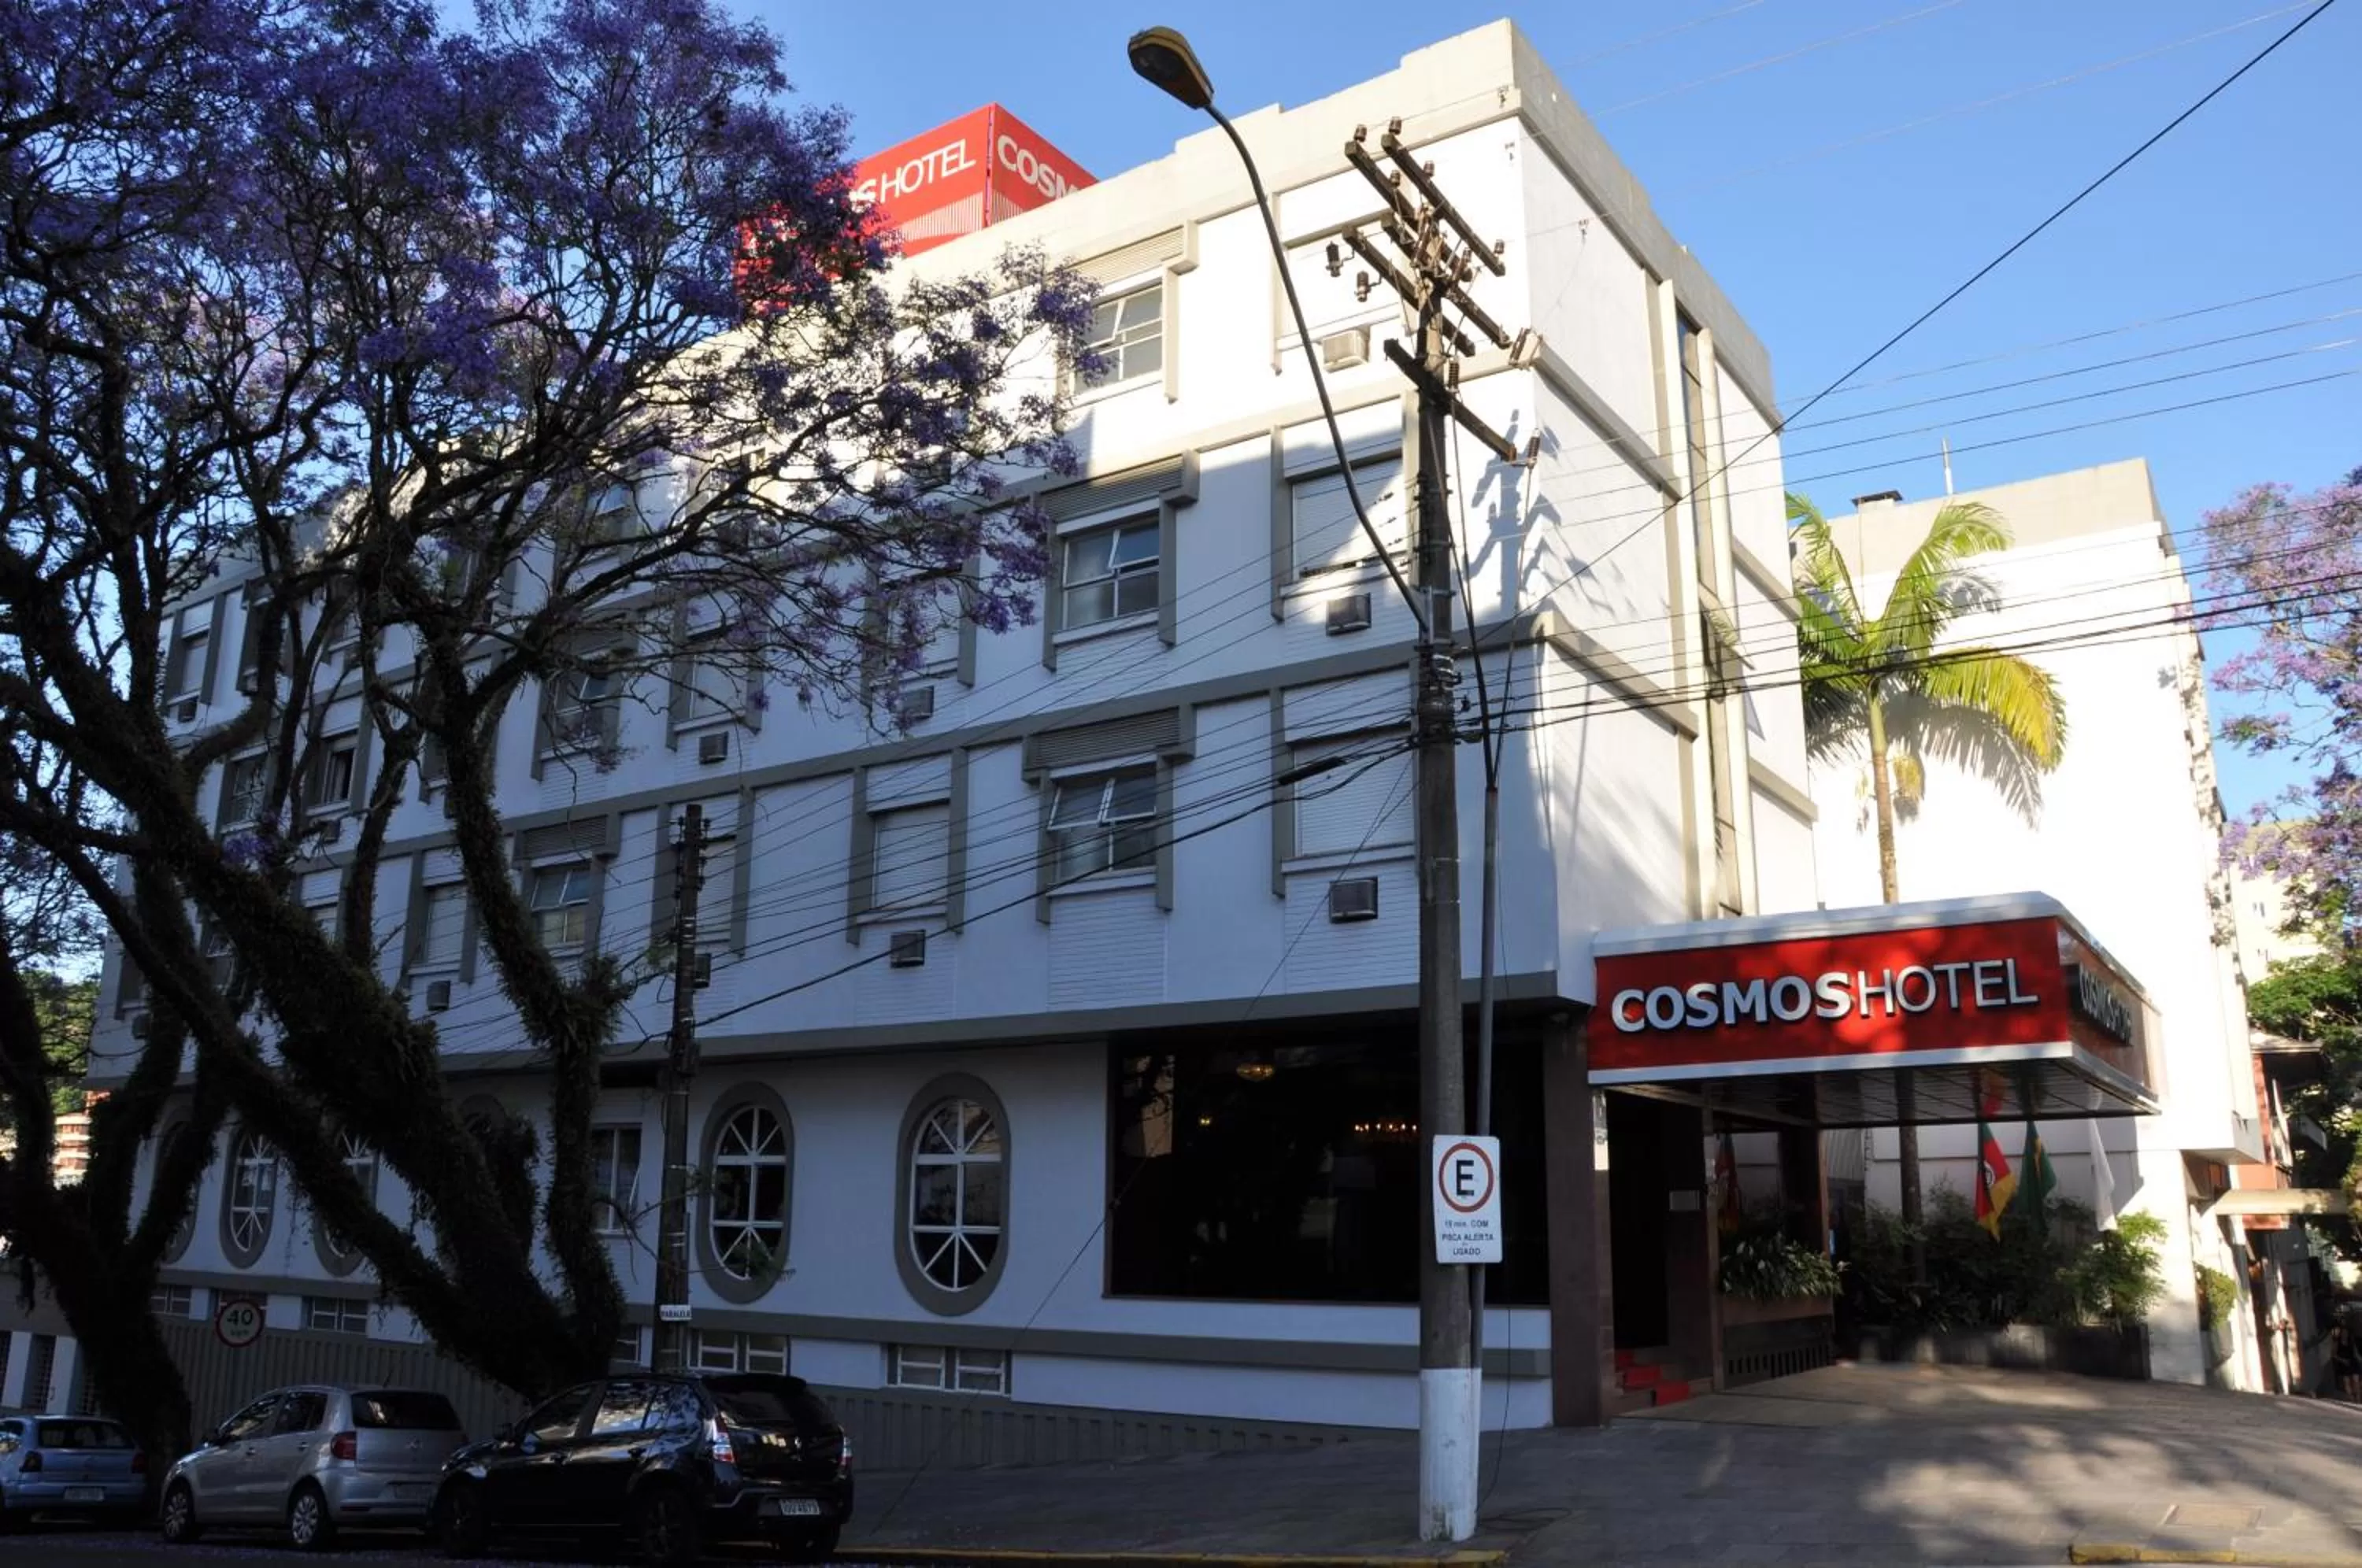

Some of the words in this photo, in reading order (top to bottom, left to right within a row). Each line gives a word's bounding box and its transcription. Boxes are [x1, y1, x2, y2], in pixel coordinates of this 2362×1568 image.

[1457, 1159, 1475, 1196] E
[1470, 1219, 1490, 1228] COM
[1442, 1233, 1461, 1241] PISCA
[1464, 1233, 1494, 1241] ALERTA
[226, 1309, 254, 1326] 40
